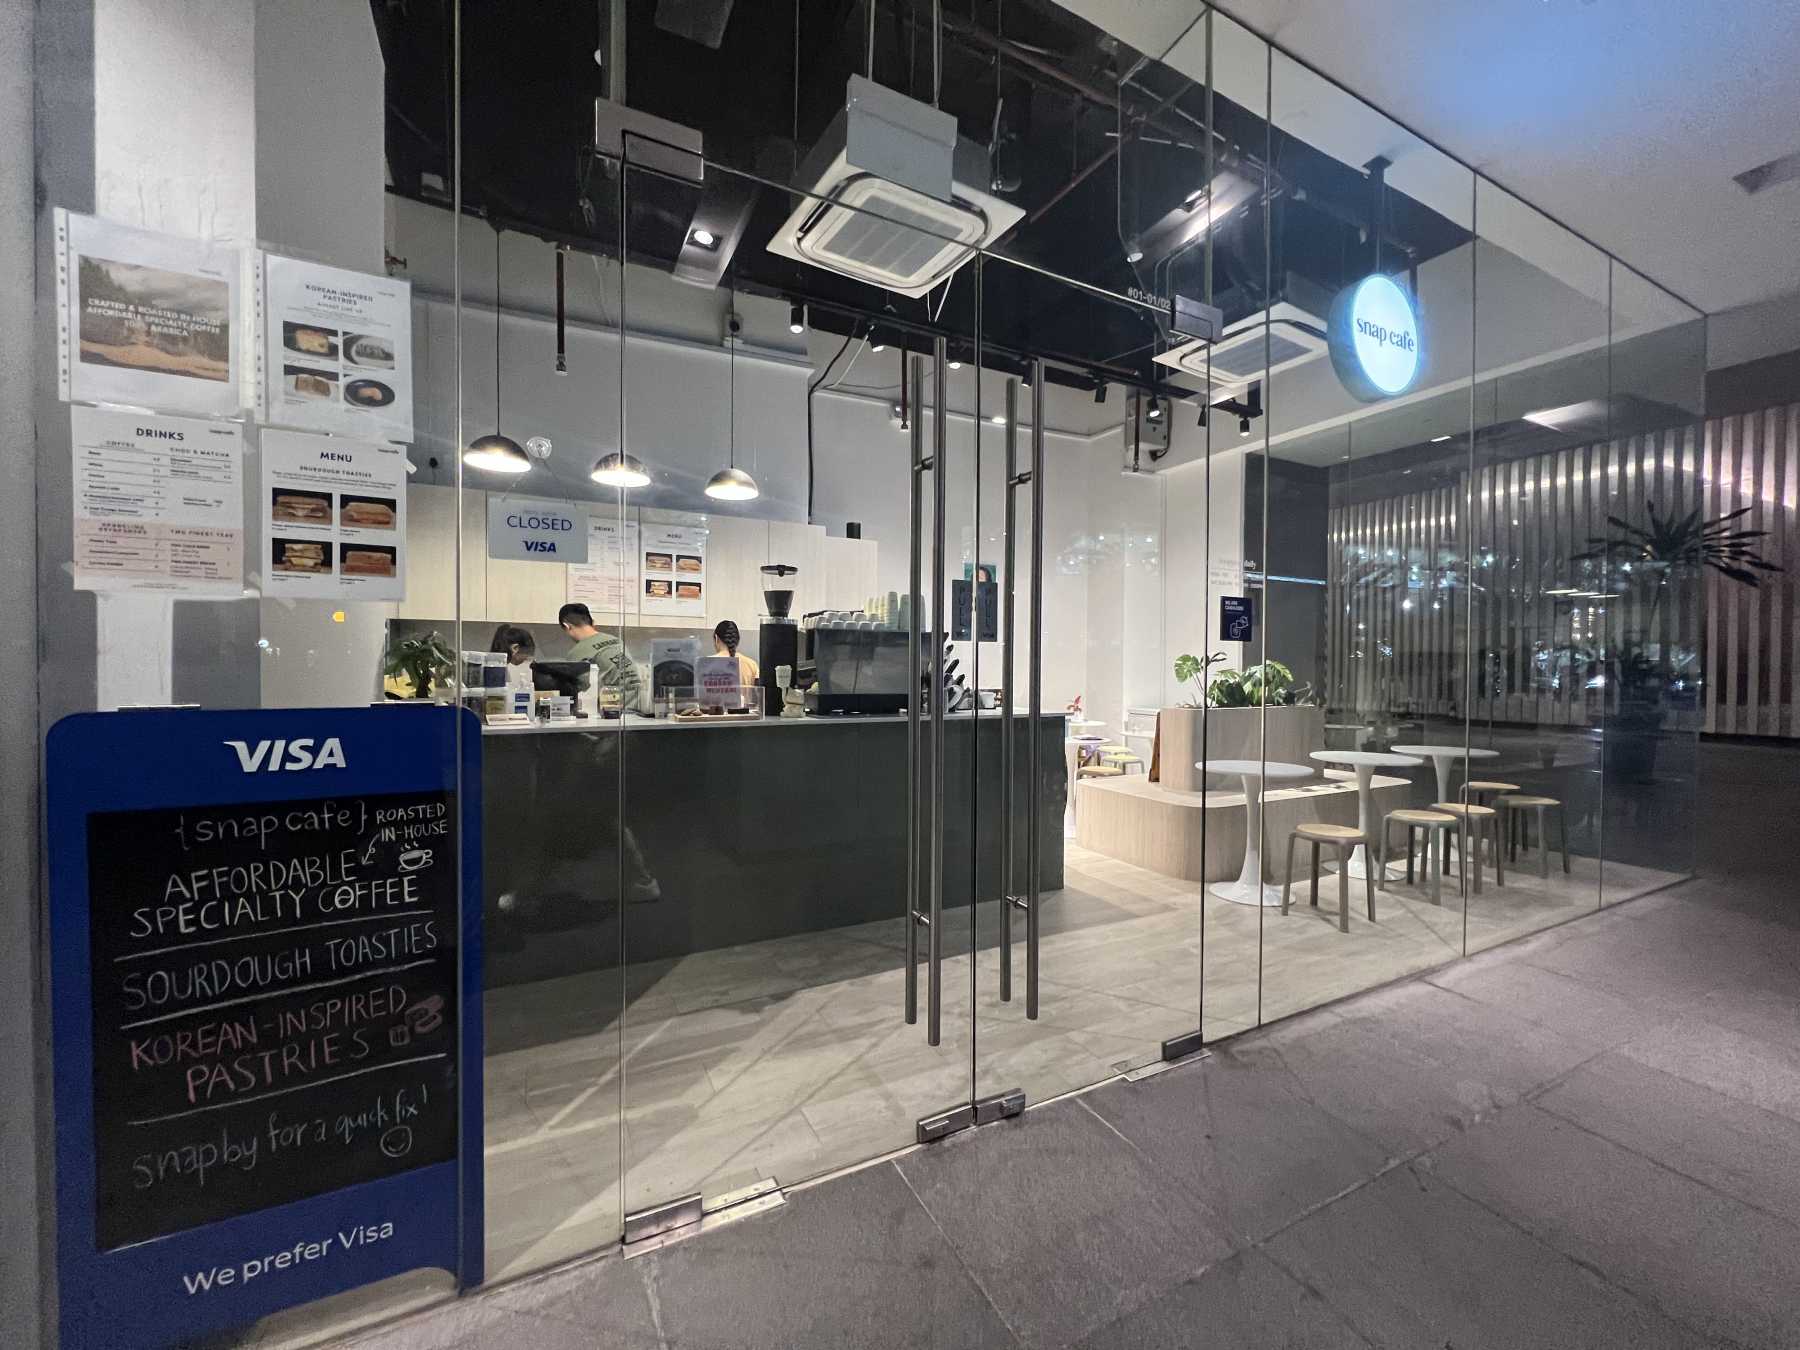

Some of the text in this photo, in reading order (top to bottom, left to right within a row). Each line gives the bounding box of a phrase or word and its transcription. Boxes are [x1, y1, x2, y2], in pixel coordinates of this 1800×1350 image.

[87, 297, 127, 310] CRAFTED
[138, 305, 178, 319] ROASTED
[192, 316, 221, 326] HOUSE
[323, 293, 358, 306] PASTRIES
[1127, 286, 1171, 310] #01-01/02
[86, 307, 221, 334] AFFORDABLE SPECIALTY COFFEE
[150, 324, 190, 337] ARABICA
[1357, 318, 1415, 353] snap cafe
[135, 427, 185, 441] DRINKS
[320, 451, 353, 463] MENU
[506, 515, 573, 531] CLOSED
[521, 540, 557, 553] VISA
[223, 737, 346, 772] VISA
[376, 802, 446, 825] ROASTED
[381, 819, 449, 841] IN-HOUSE
[164, 848, 357, 903] AFFORDABLE
[130, 875, 418, 938] SPECIALTY COFFEE
[123, 919, 437, 1012] SOURDOUGH TOASTIES
[131, 984, 407, 1071] KOREAN-INSPIRED
[185, 1027, 370, 1105] PASTRIES
[335, 1095, 389, 1145] quick
[183, 1221, 395, 1296] We prefer Visa
